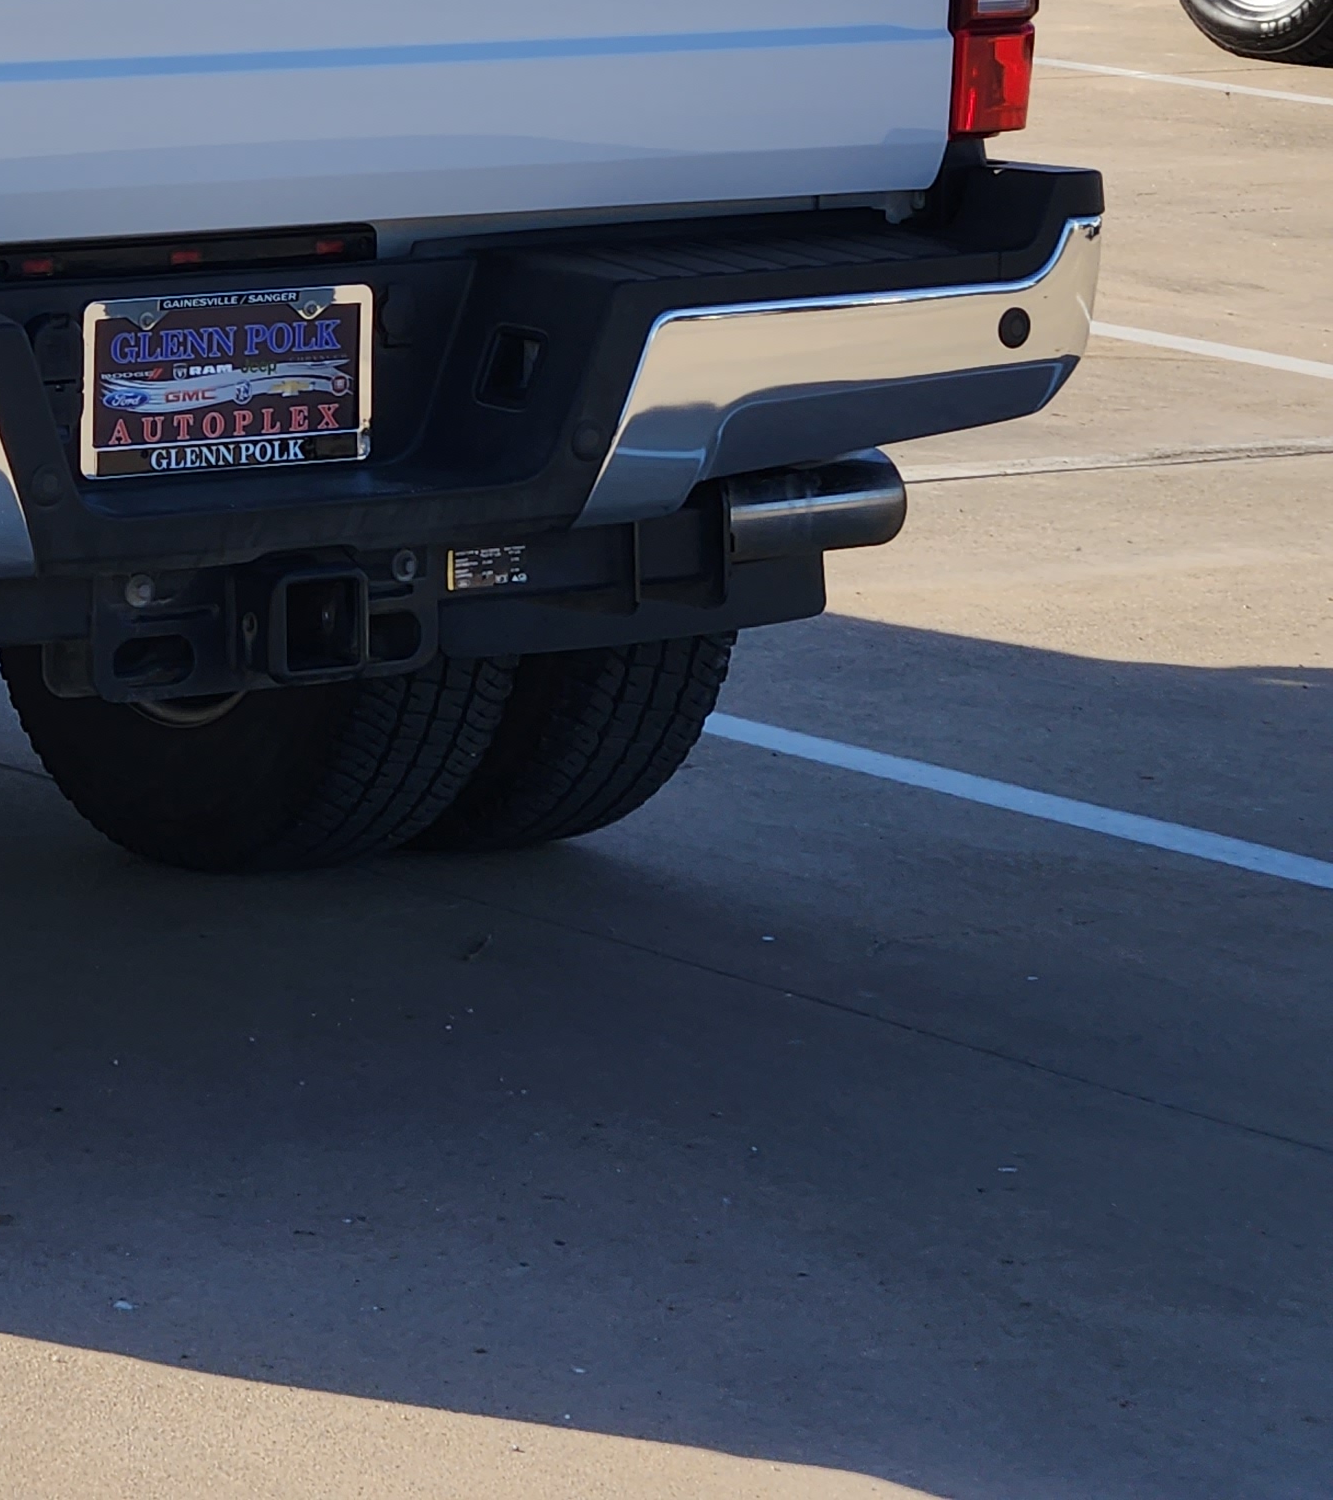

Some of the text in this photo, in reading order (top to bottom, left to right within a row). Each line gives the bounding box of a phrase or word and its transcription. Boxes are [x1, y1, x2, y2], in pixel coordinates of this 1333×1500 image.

[162, 294, 240, 311] GAINESVILLE
[247, 291, 298, 304] SANGER
[110, 318, 343, 365] GLENN POLK
[188, 363, 234, 376] RAM
[164, 387, 217, 404] GMC
[108, 403, 341, 446] AUTOPLEX
[149, 439, 305, 471] GLENN POLK
